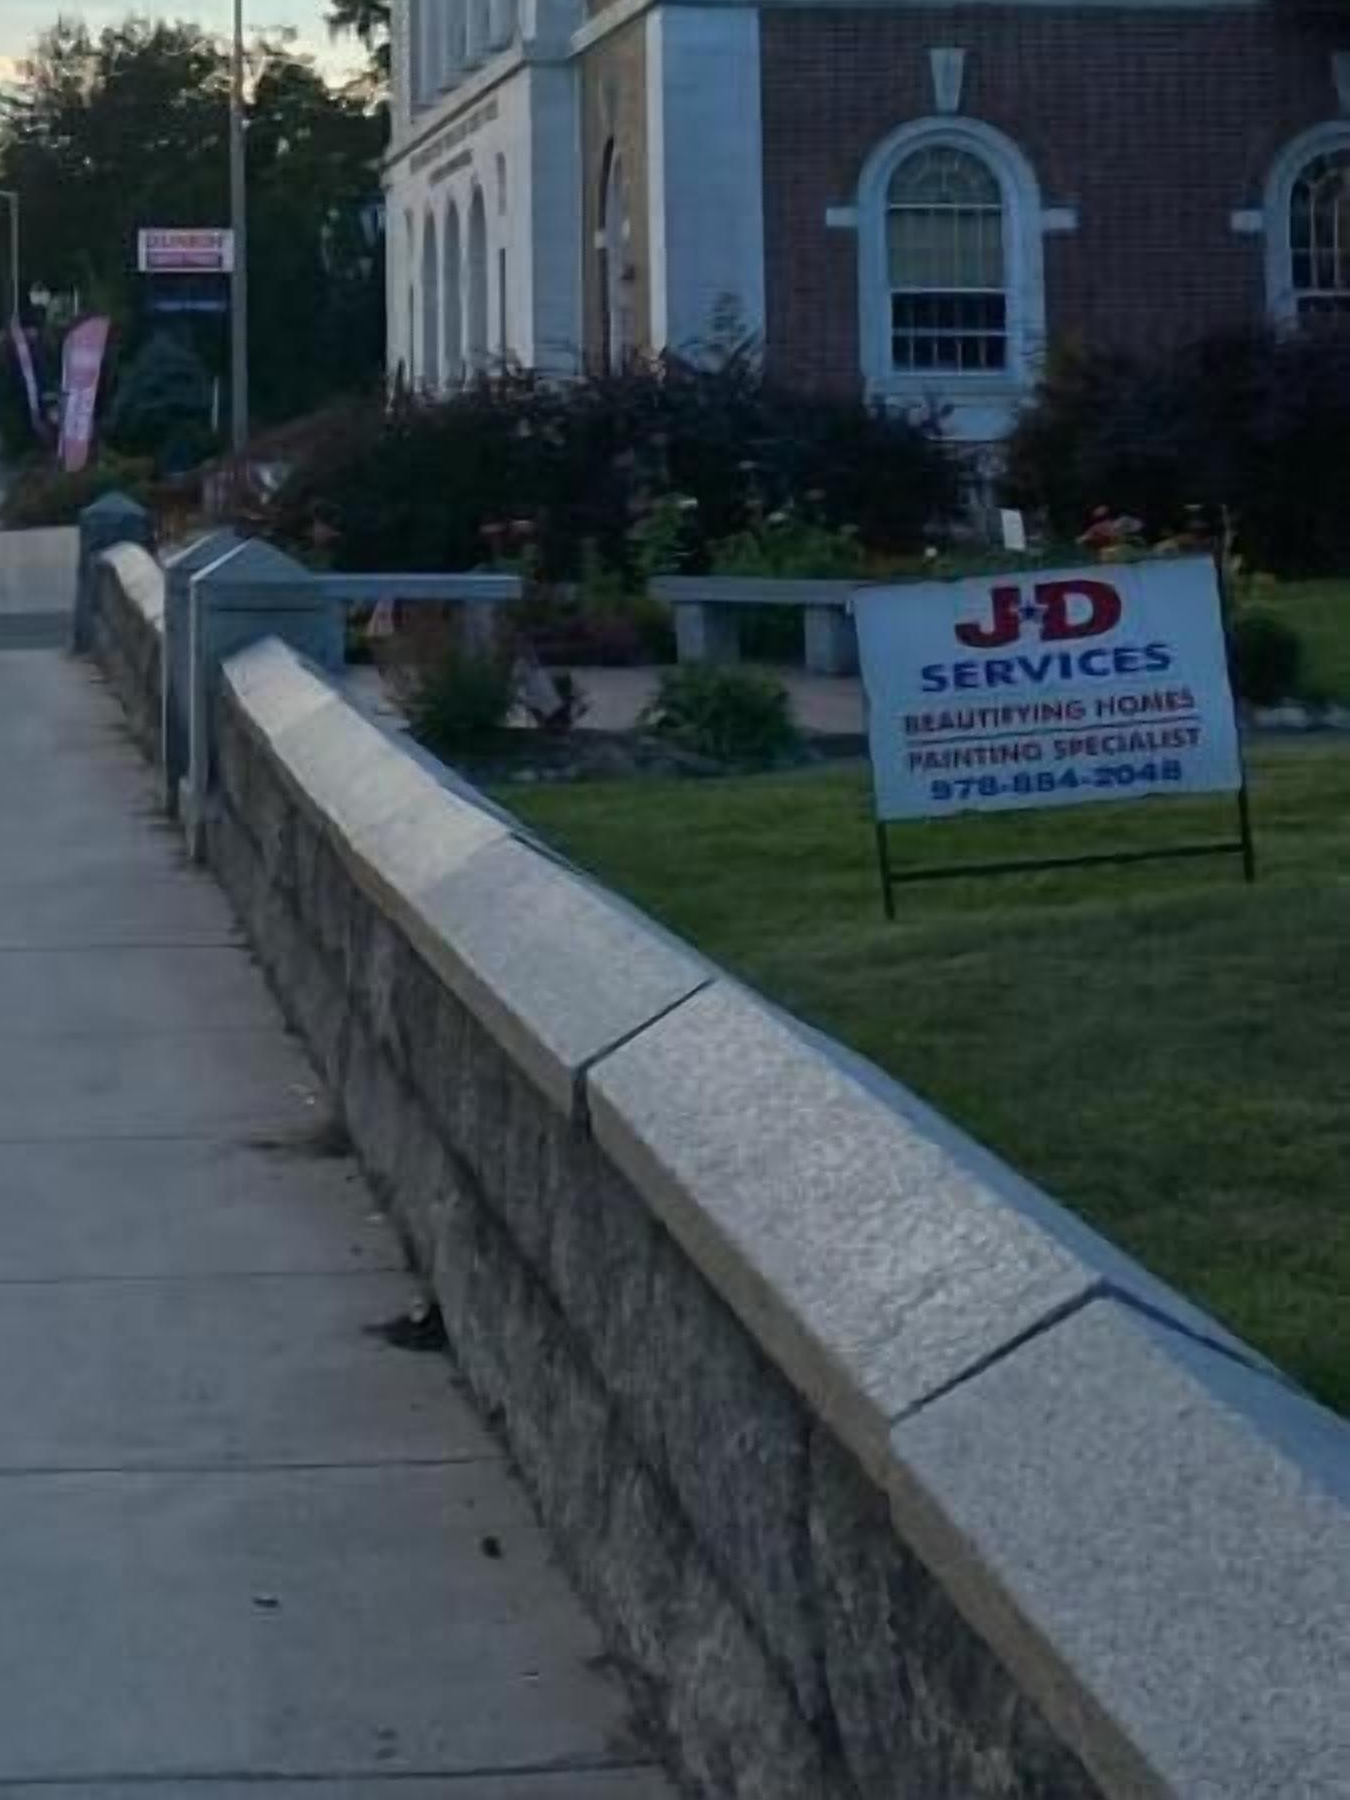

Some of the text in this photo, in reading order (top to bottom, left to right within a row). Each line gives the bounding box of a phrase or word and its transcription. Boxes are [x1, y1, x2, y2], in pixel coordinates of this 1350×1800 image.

[921, 643, 1171, 692] SERVICES
[905, 689, 1194, 734] BEAUTIFYING HOMES
[909, 728, 1198, 770] PAINTING SPECIALIST
